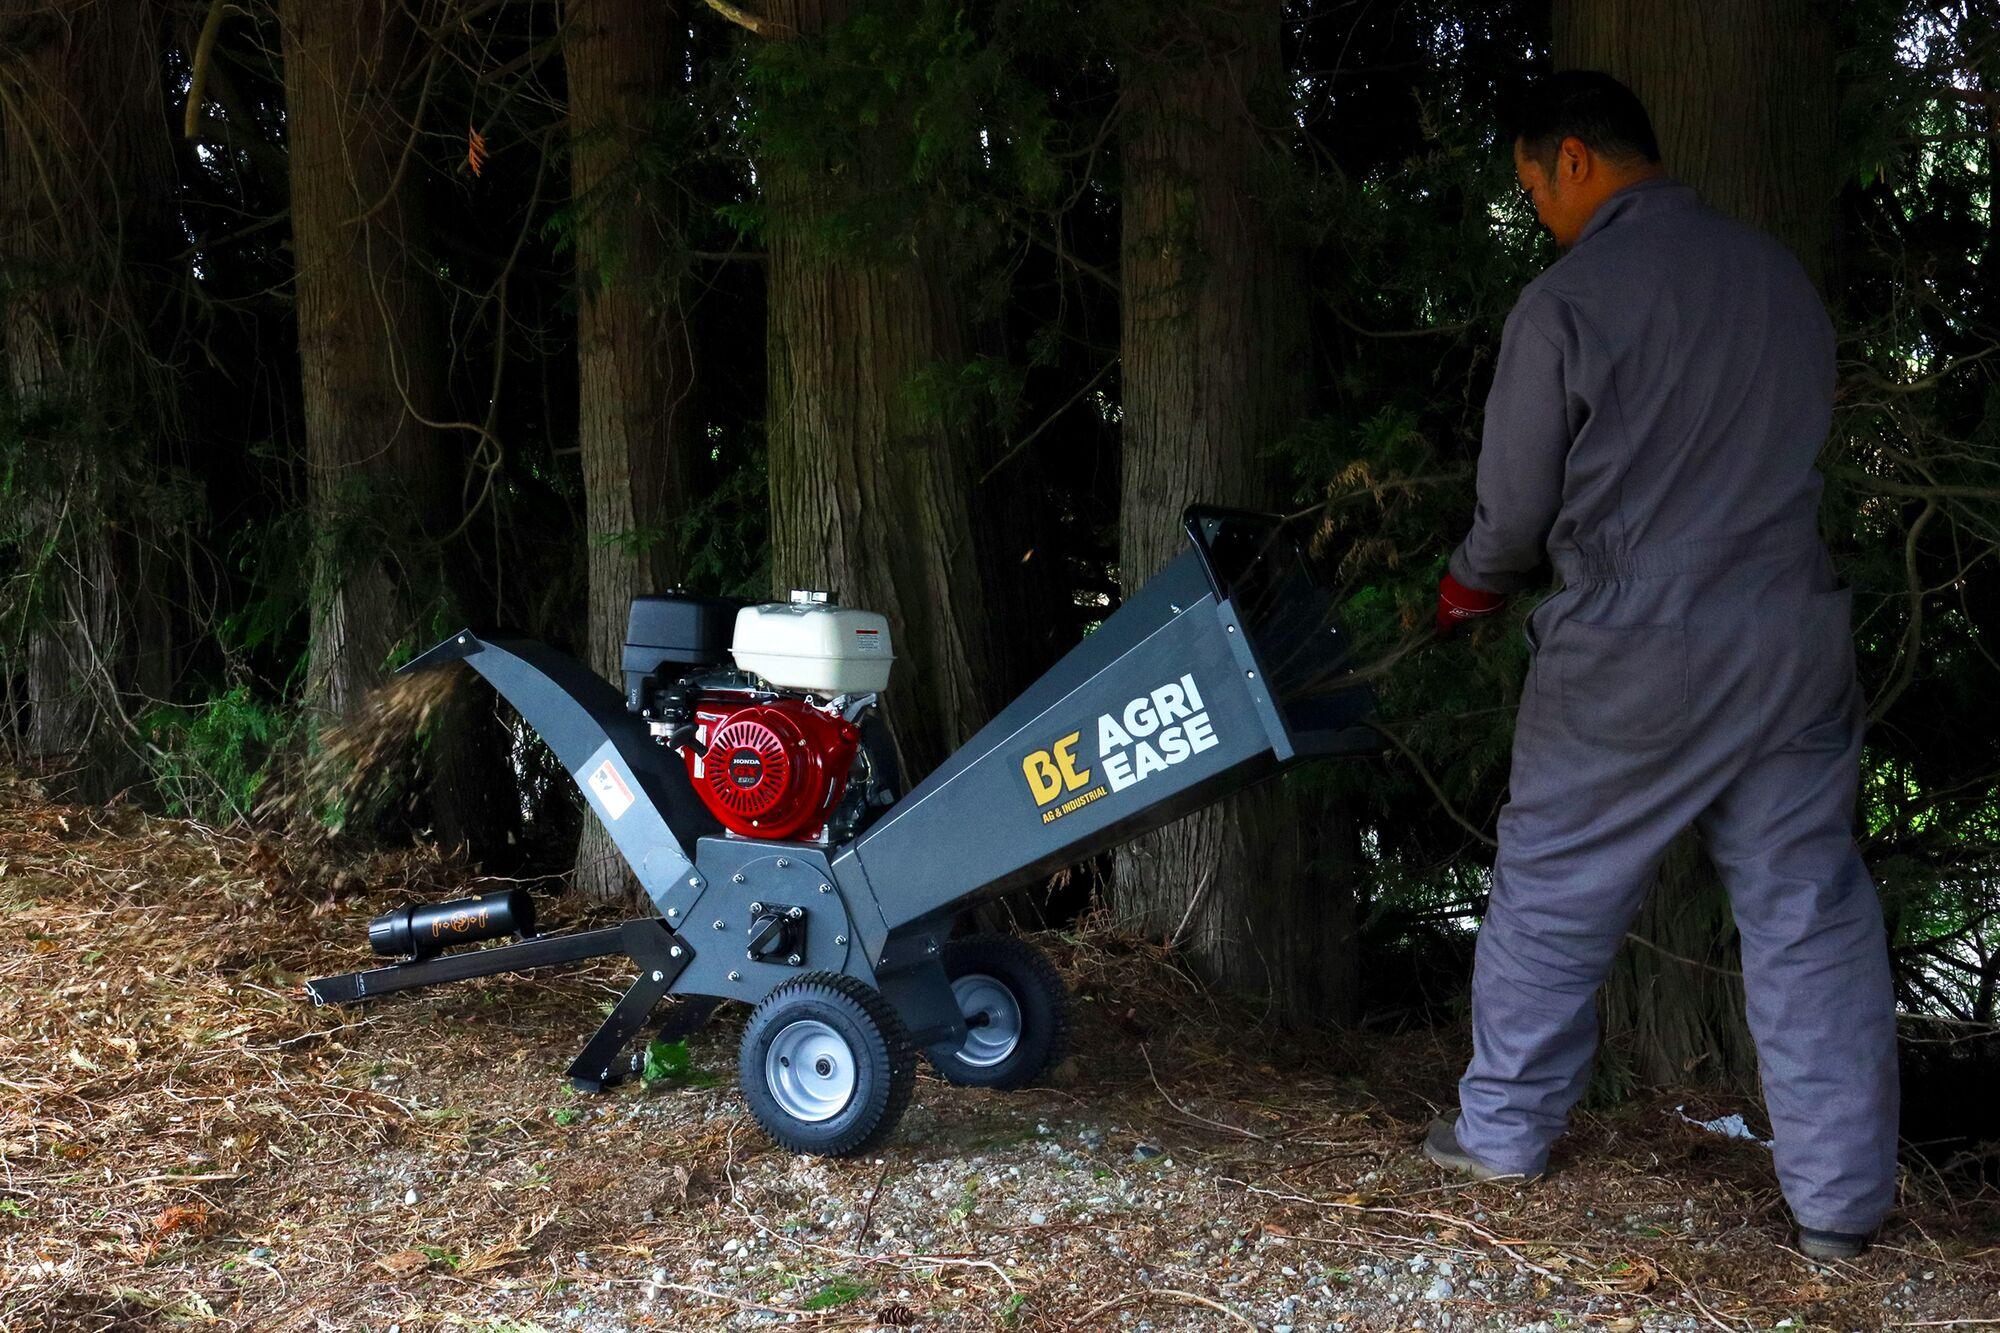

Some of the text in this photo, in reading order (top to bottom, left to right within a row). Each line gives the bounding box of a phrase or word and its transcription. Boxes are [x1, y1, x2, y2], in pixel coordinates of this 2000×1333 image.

[1098, 673, 1205, 758] AGRI
[1102, 712, 1220, 793] EASE
[1022, 731, 1090, 807] BE
[1042, 786, 1108, 824] AG & INDUSTRIAL
